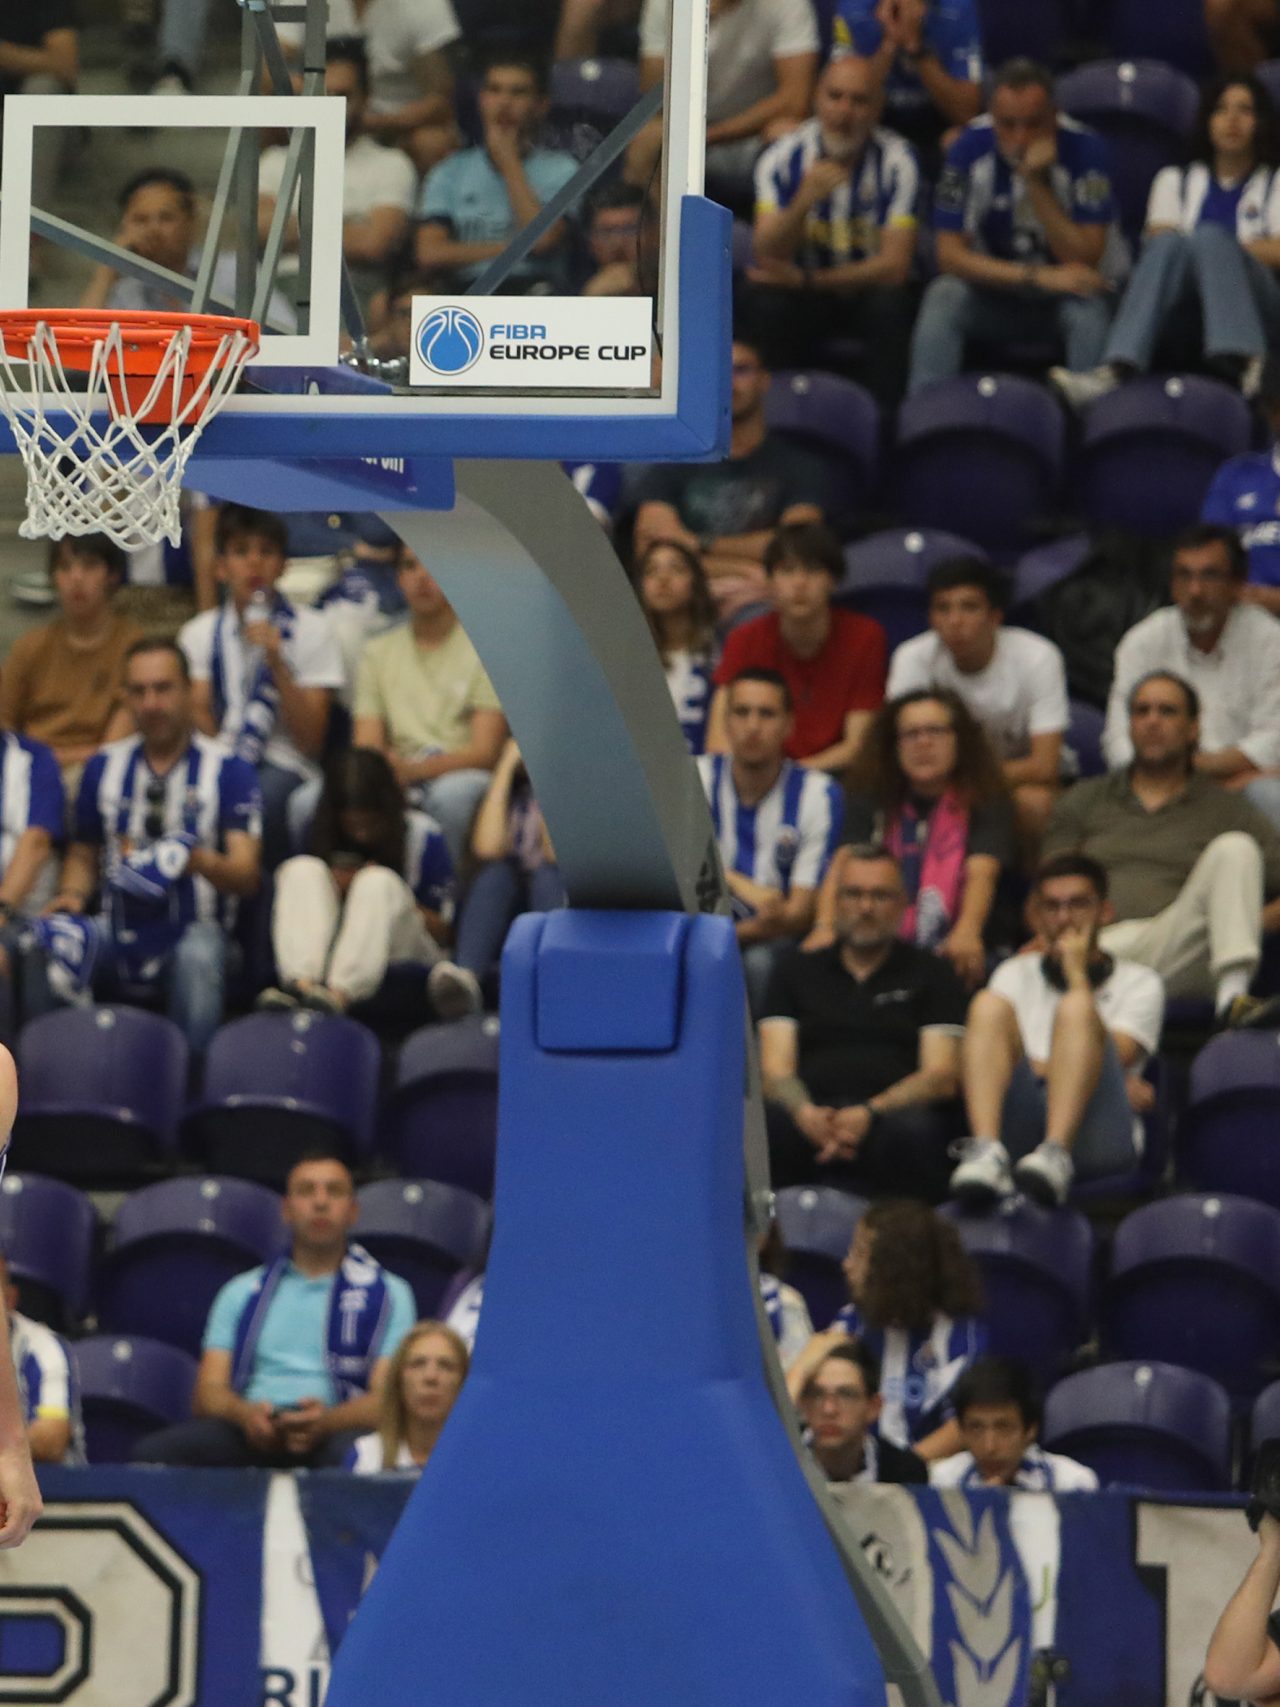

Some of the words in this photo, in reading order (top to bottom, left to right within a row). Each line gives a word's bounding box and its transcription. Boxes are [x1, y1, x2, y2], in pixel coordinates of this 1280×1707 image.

[489, 324, 547, 340] FIBA
[489, 345, 590, 360] EUROPE
[598, 345, 647, 361] CUP
